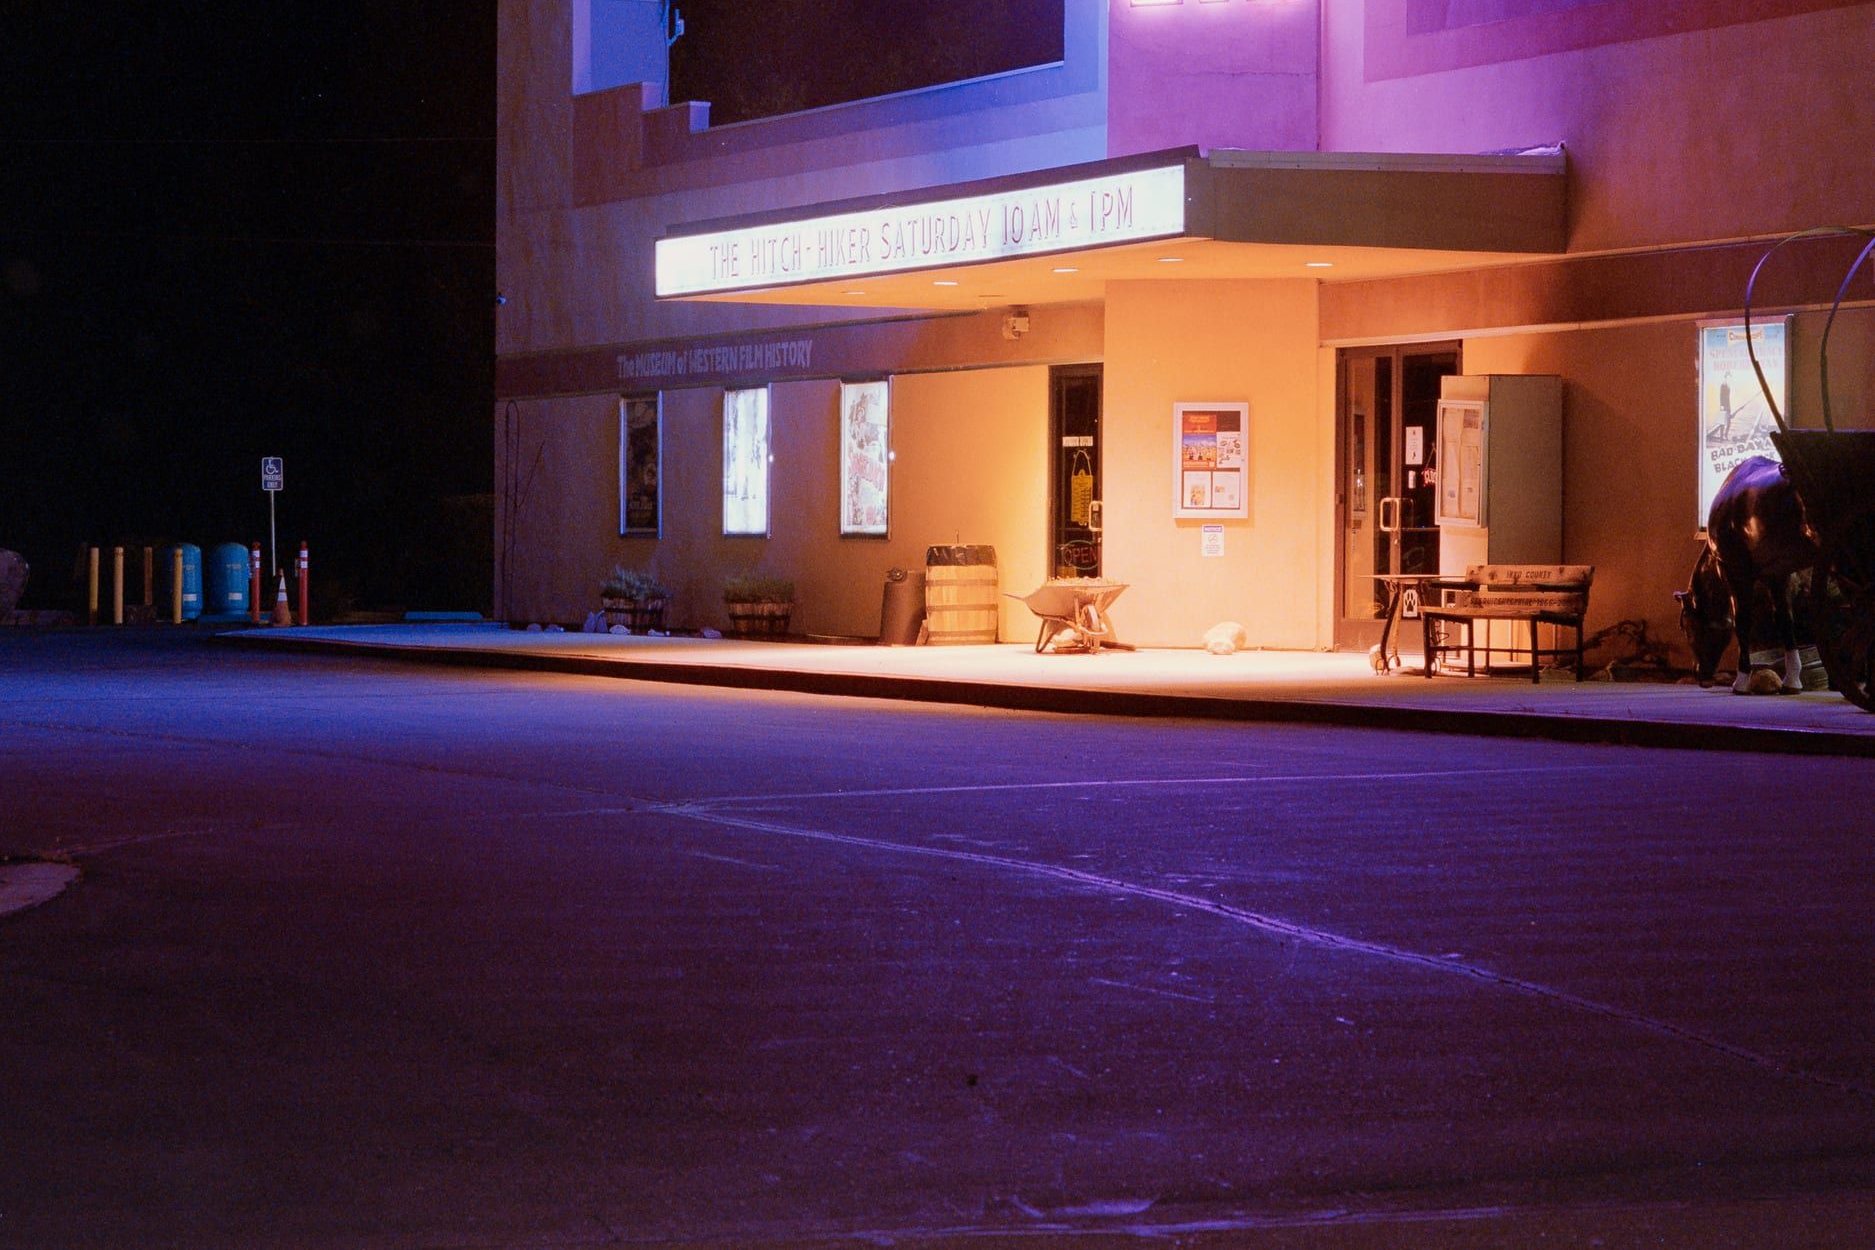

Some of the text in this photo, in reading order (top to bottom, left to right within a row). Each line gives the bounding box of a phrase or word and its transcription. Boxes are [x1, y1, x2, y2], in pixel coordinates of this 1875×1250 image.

[709, 243, 738, 280] THE
[881, 208, 991, 261] SATURDAY
[636, 350, 675, 377] MUSEUM
[677, 350, 687, 375] of
[688, 346, 738, 374] WESTERN
[739, 344, 763, 370] FILM
[764, 340, 813, 370] HISTORY
[1064, 547, 1097, 566] OPEN
